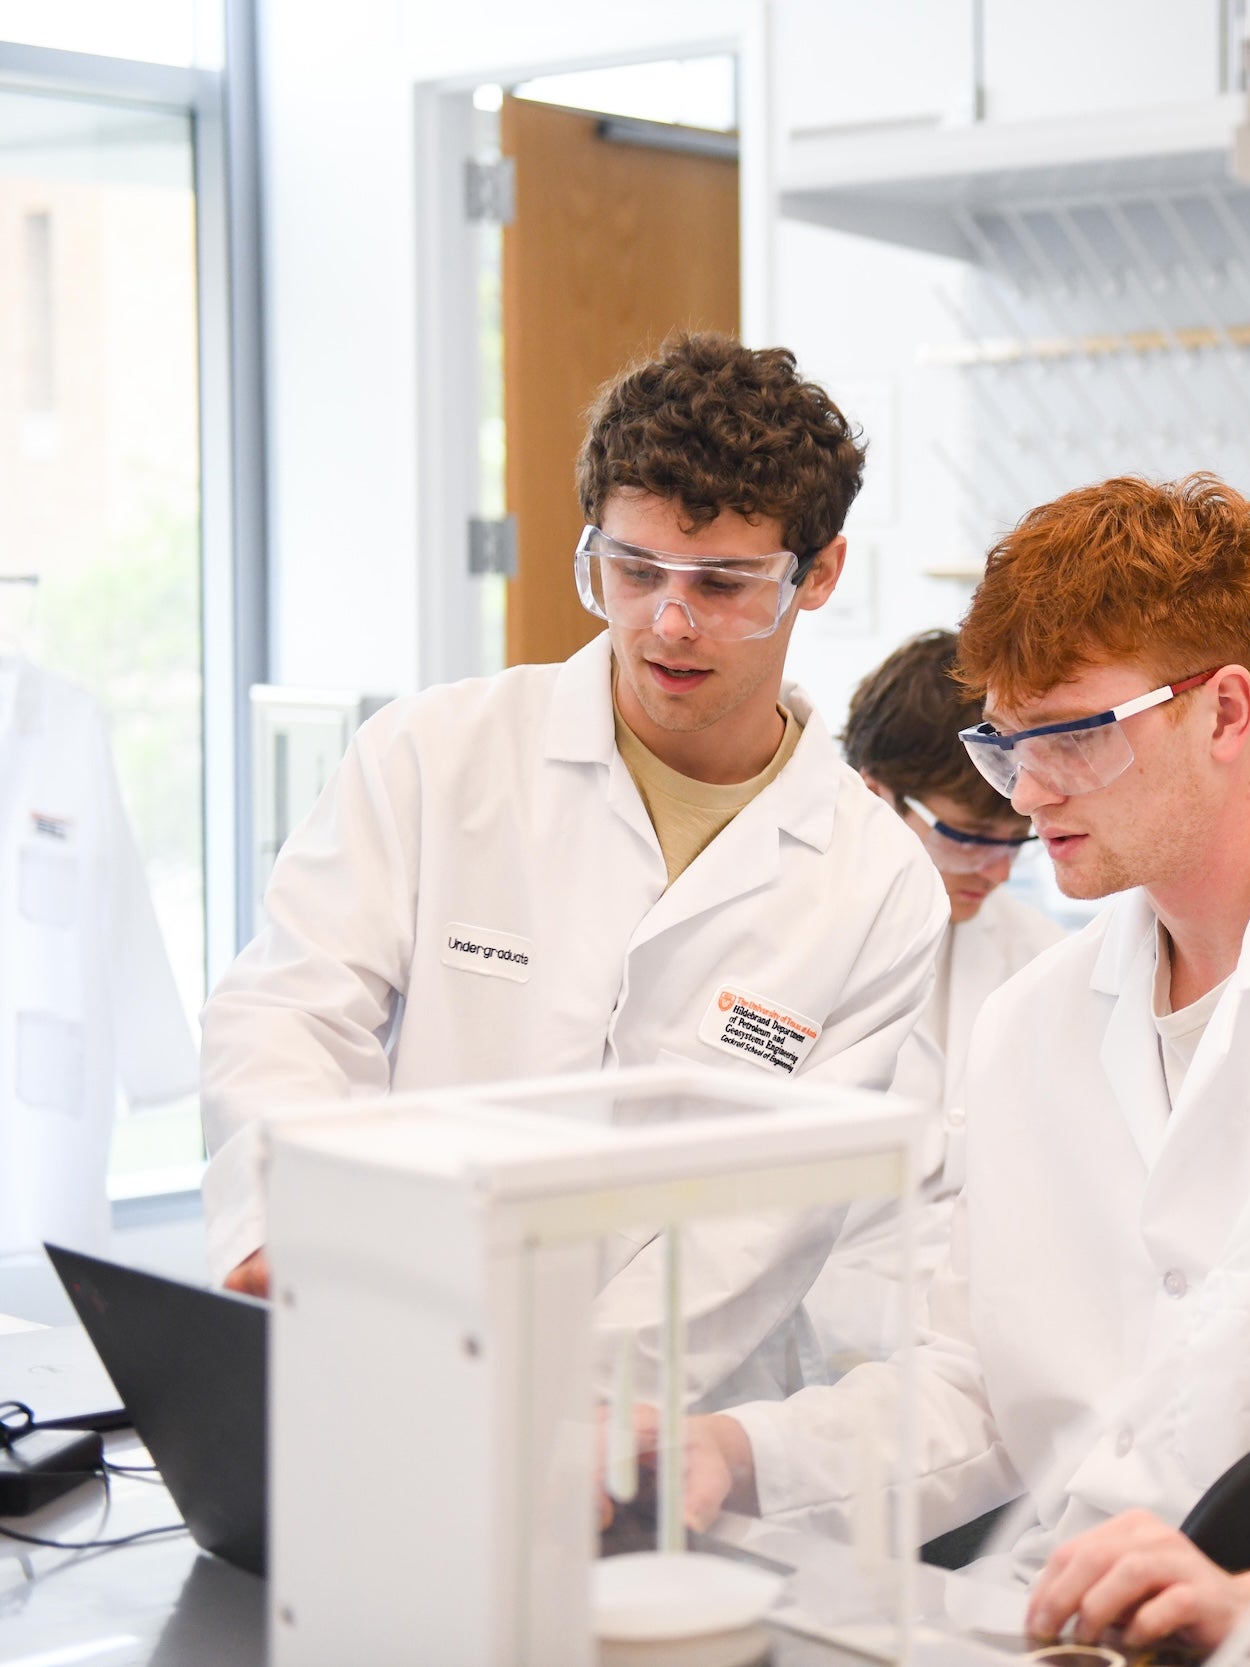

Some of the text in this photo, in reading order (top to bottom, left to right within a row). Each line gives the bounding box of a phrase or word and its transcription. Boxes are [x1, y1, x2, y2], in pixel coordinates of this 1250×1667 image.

[448, 936, 529, 966] Undergraduate
[733, 1005, 805, 1043] Hildebrand Department
[738, 1018, 771, 1038] Petroleum
[772, 1035, 786, 1045] and
[725, 1024, 799, 1065] Geosystems Engineering
[744, 1043, 764, 1057] School
[769, 1056, 794, 1074] Engineering
